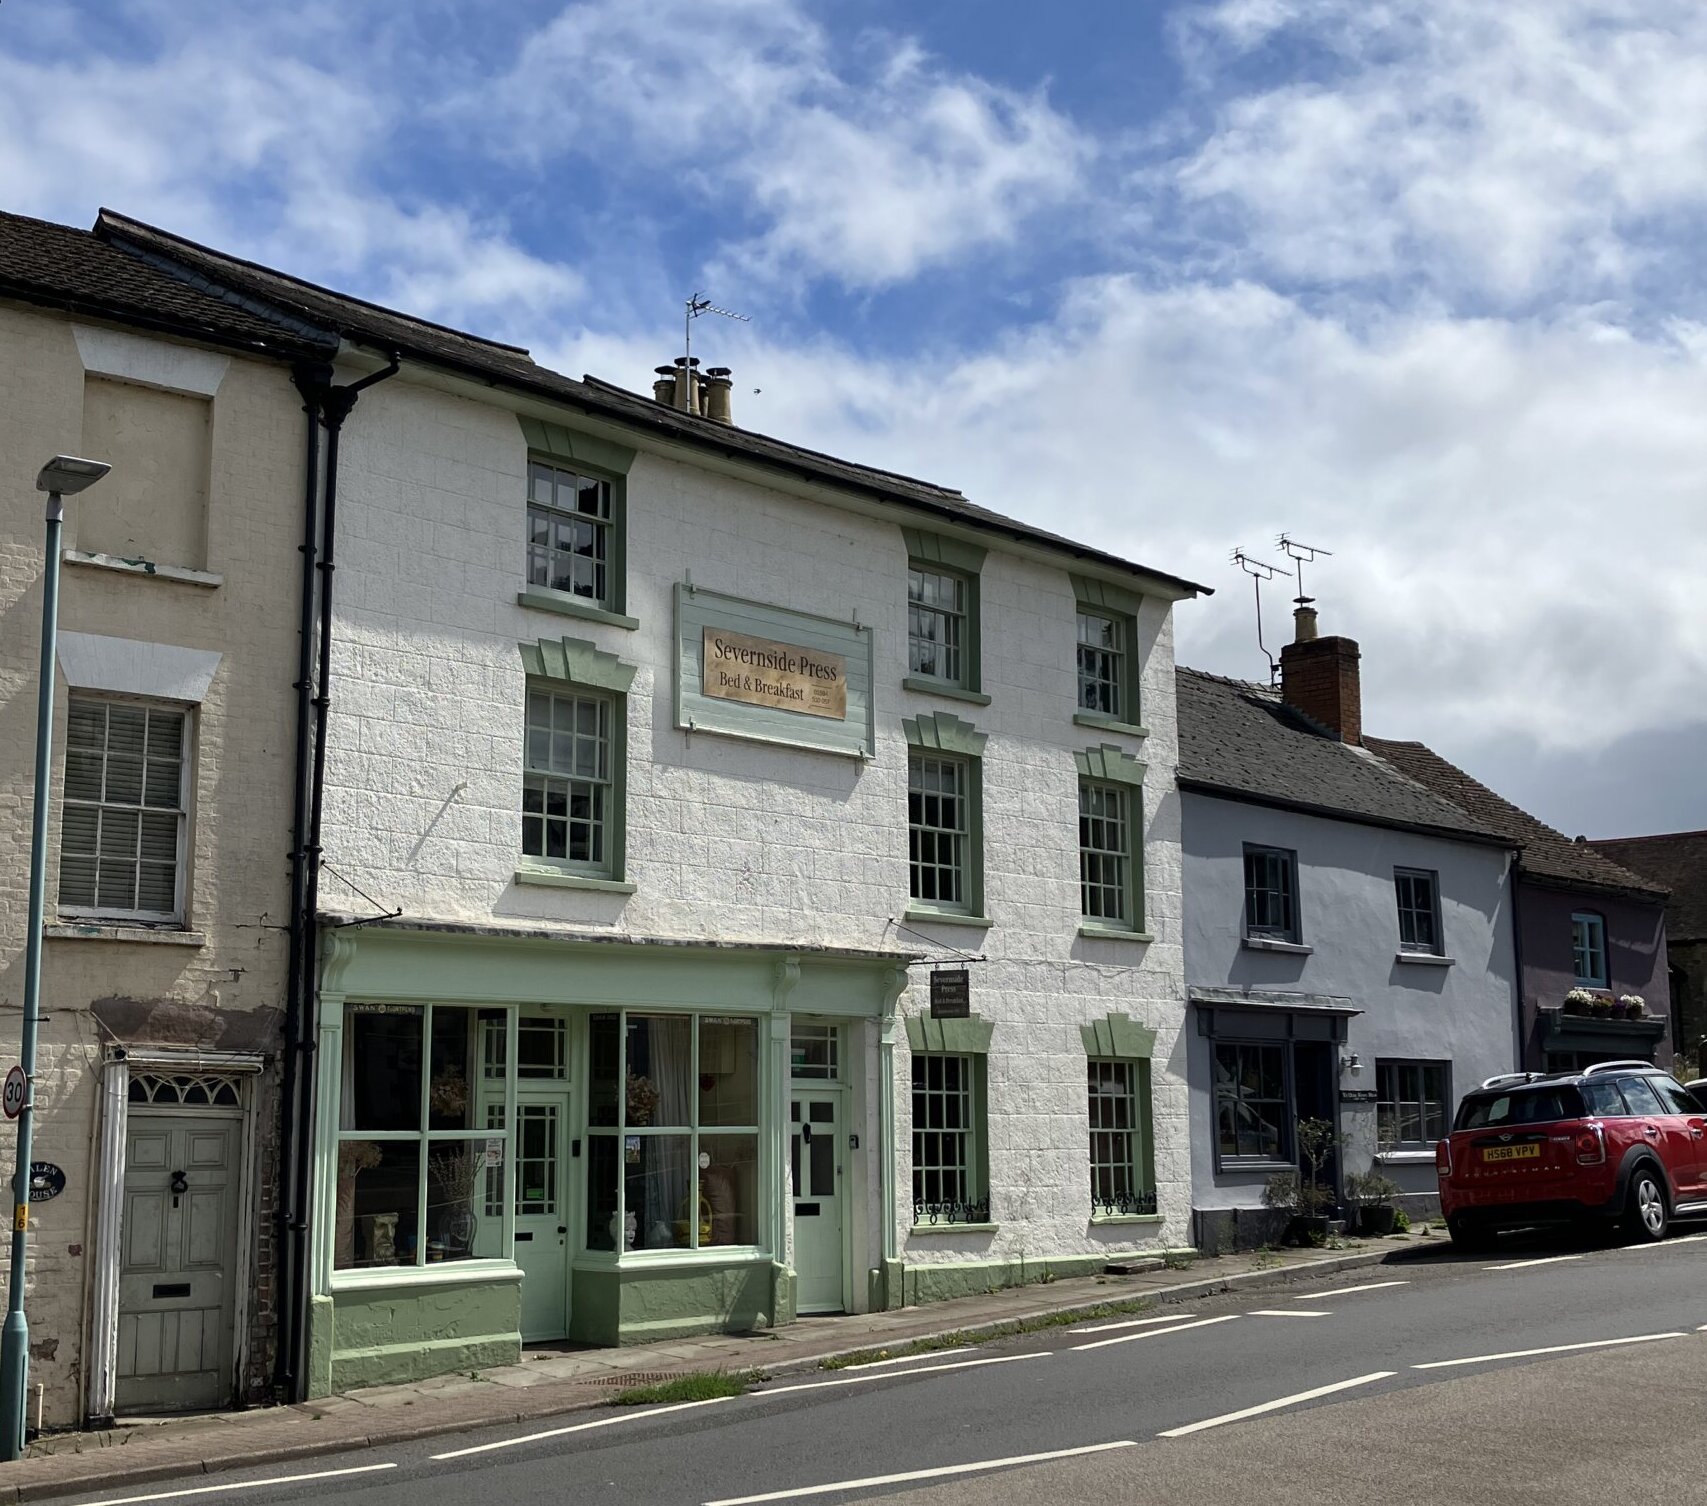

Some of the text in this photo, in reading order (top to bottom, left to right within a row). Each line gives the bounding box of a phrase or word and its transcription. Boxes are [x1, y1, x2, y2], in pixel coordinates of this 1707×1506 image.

[715, 638, 837, 681] Severnside Press
[720, 671, 741, 689] Bed
[743, 675, 752, 691] &
[755, 678, 804, 701] Breakfast
[6, 1082, 22, 1102] 30
[1487, 1147, 1513, 1159] HS68
[30, 1164, 58, 1176] ALEN
[29, 1187, 58, 1199] OUSE
